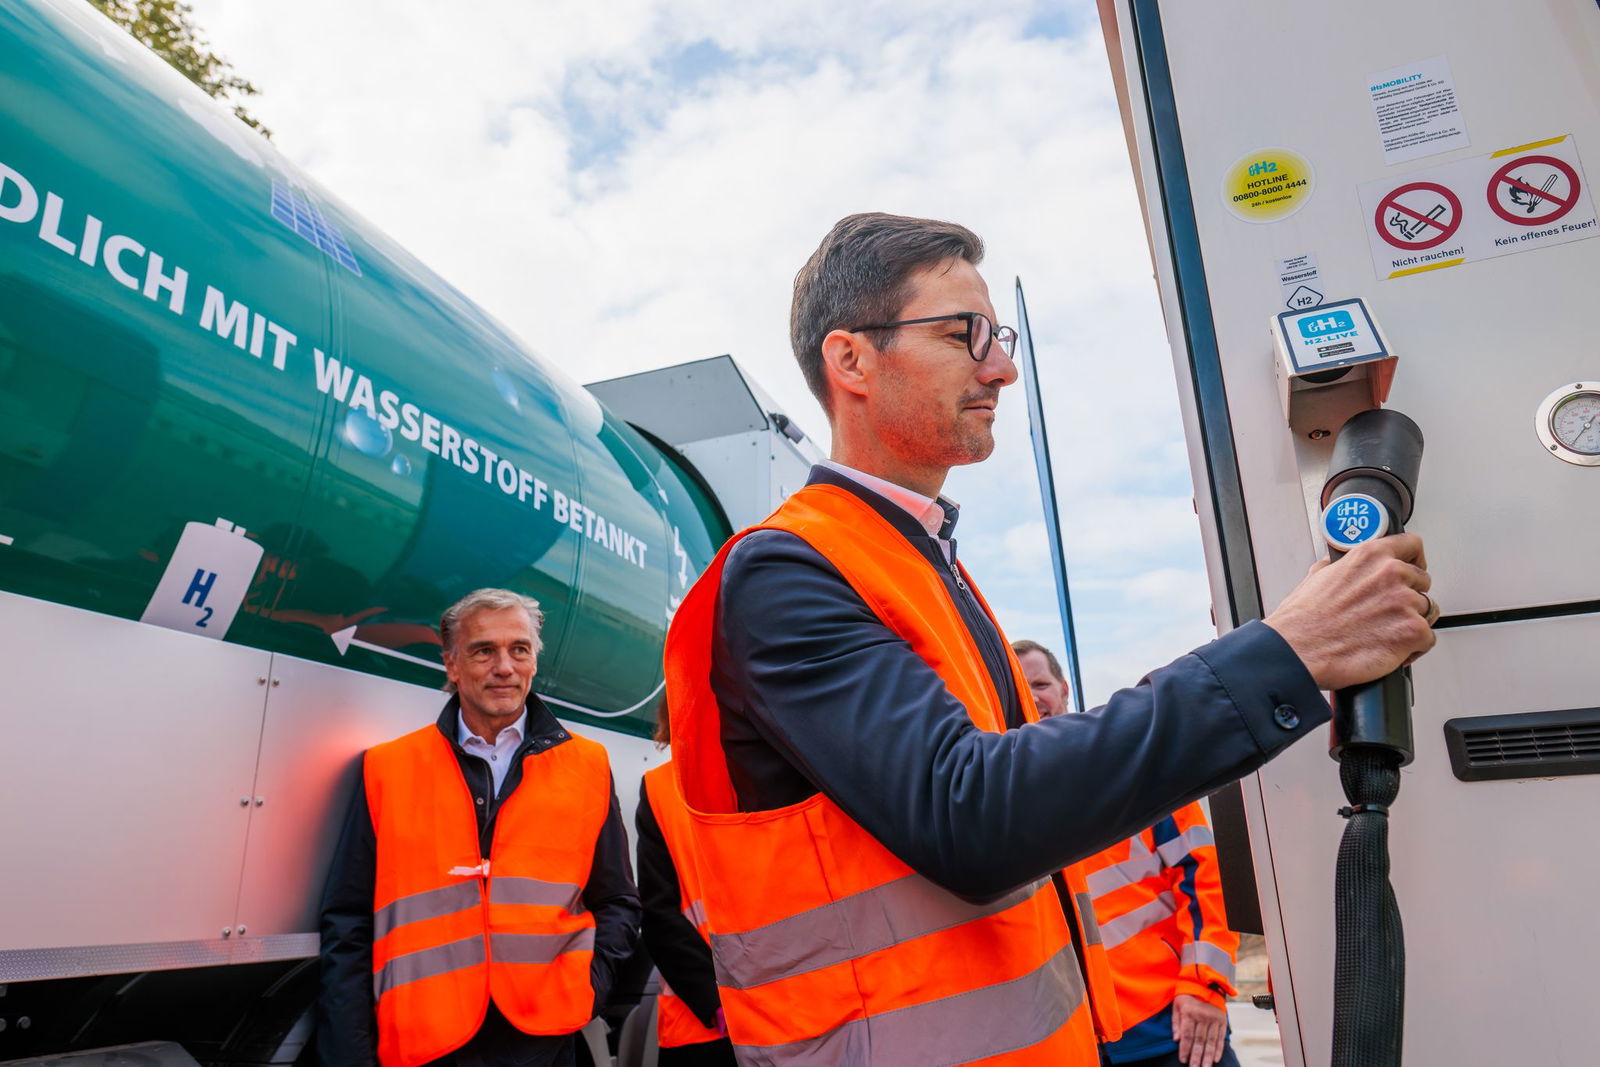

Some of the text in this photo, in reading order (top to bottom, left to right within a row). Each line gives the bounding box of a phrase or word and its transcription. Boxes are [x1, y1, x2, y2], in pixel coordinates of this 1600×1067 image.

[1232, 178, 1307, 203] 00800-8000 4444
[1247, 173, 1289, 190] HOTLINE
[1494, 218, 1597, 247] Kein offenes Feuer!
[1392, 246, 1465, 268] Nicht rauchen!
[1281, 270, 1317, 282] Wasserstoff
[1297, 296, 1313, 307] H2
[1304, 330, 1360, 346] H2.LIVE
[199, 285, 297, 371] MIT
[313, 347, 548, 511] WASSERSTOFF
[552, 488, 647, 569] BETANKT
[1337, 516, 1369, 531] 700
[182, 568, 218, 628] H2
